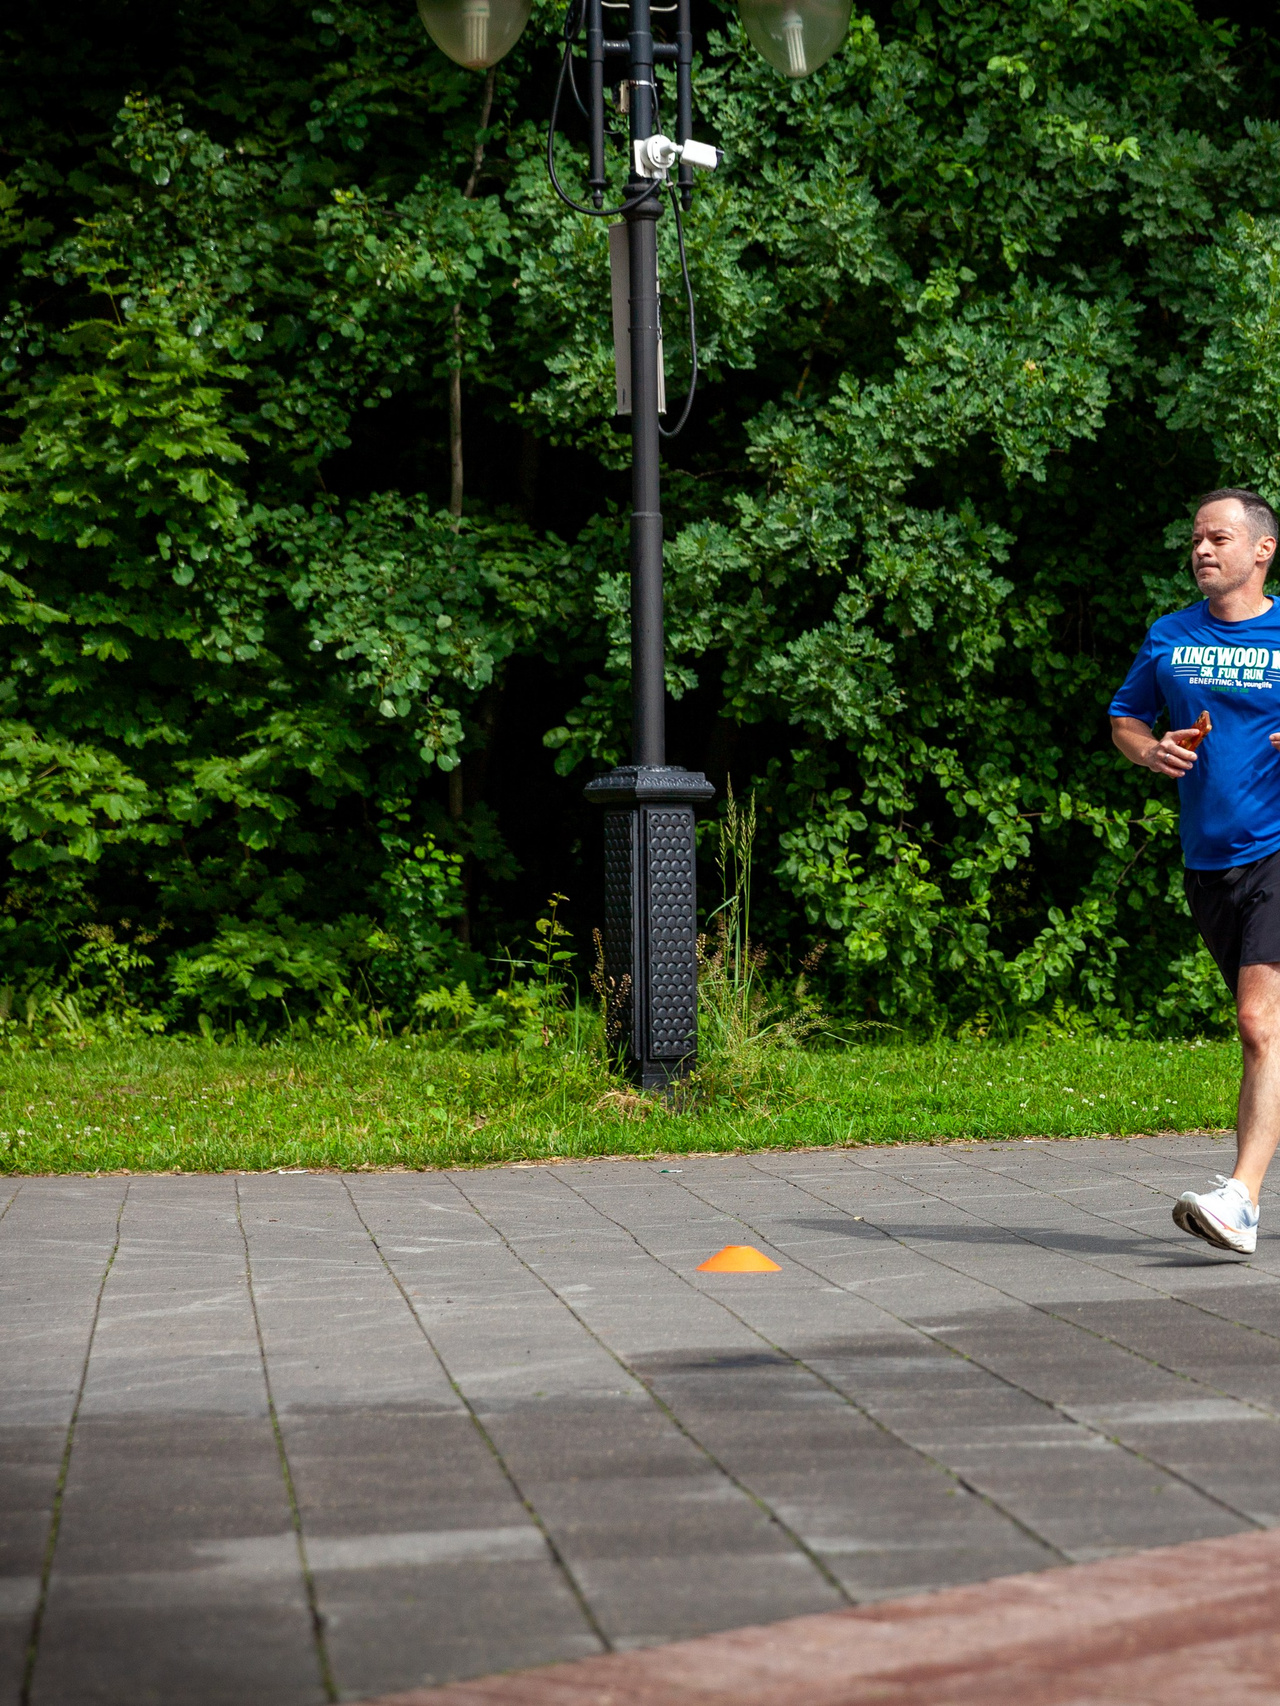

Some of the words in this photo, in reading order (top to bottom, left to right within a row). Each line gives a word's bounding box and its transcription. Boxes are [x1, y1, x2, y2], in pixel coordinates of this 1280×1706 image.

[1171, 646, 1269, 668] KINGWOOD
[1200, 666, 1214, 677] 5K
[1217, 667, 1239, 679] FUN
[1243, 668, 1264, 681] RUN
[1189, 677, 1234, 686] BENEFITING:
